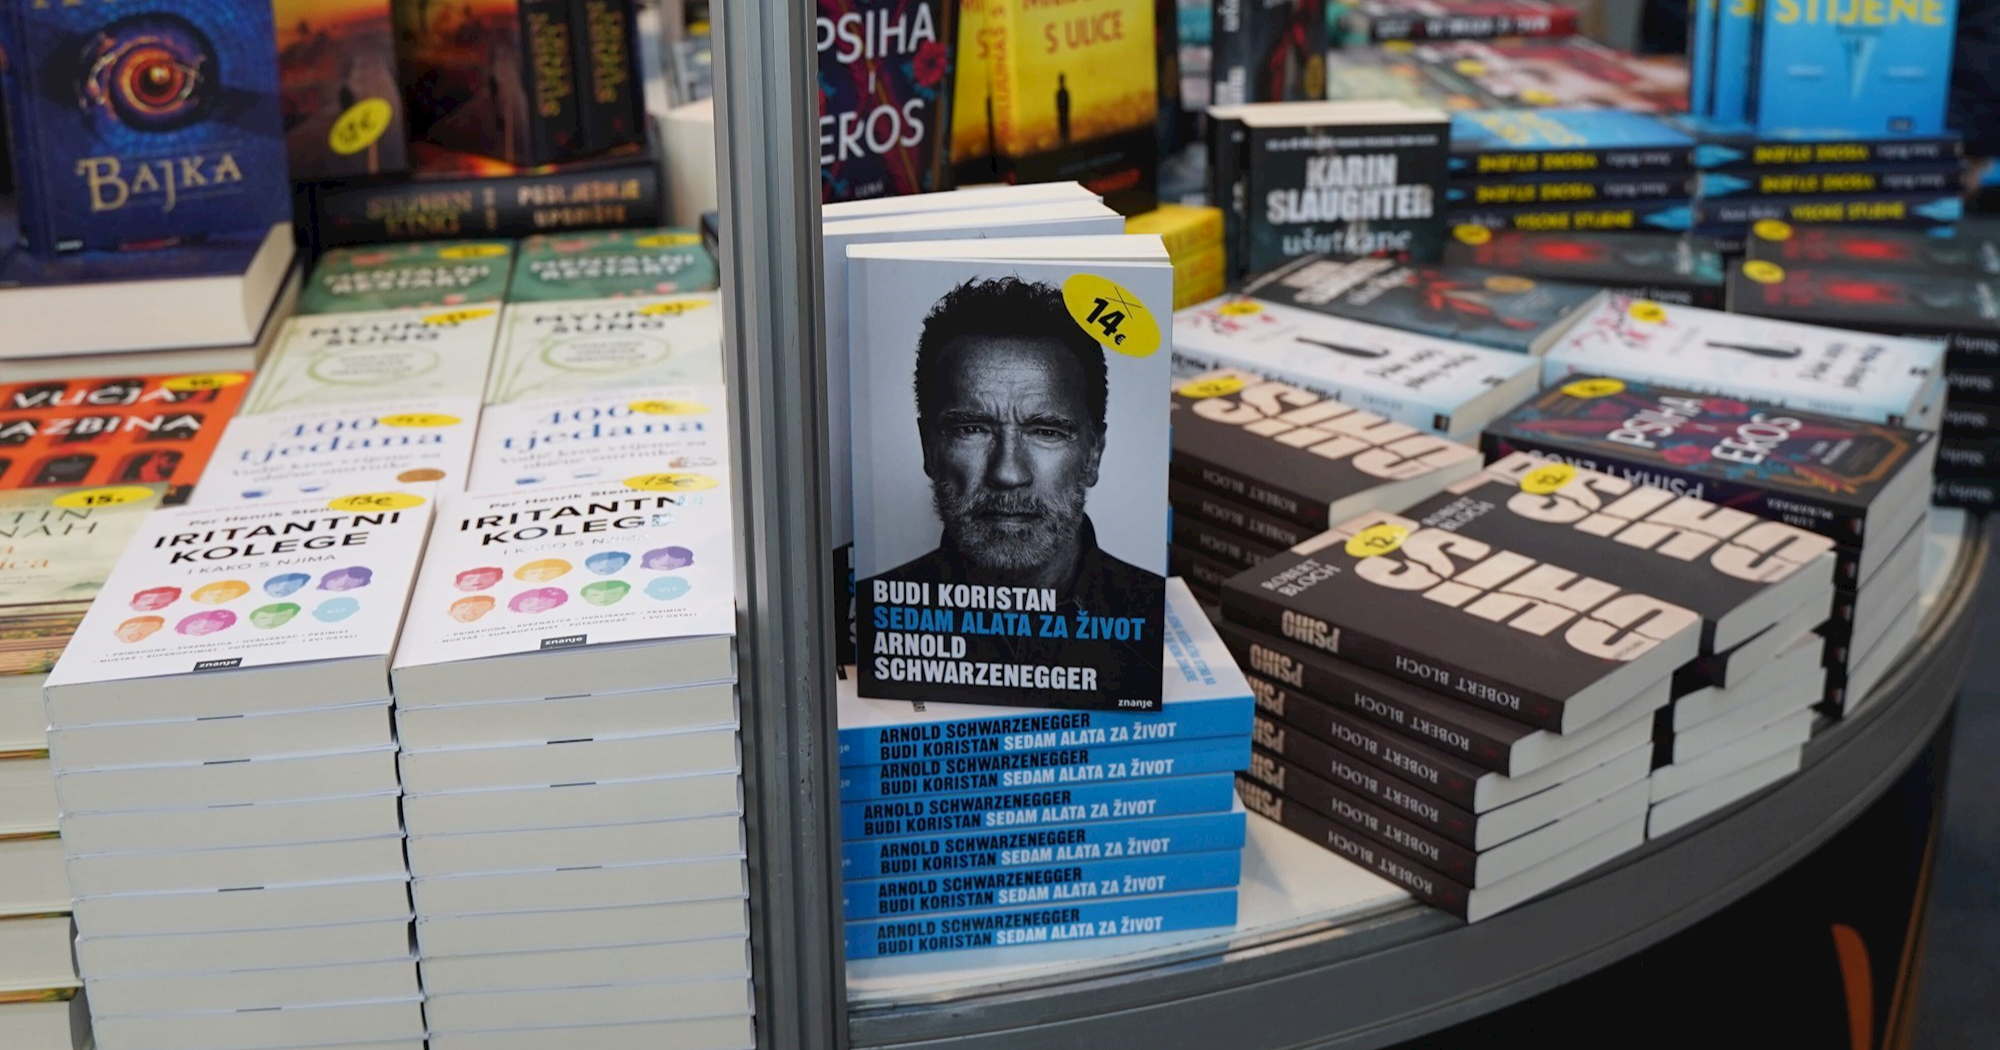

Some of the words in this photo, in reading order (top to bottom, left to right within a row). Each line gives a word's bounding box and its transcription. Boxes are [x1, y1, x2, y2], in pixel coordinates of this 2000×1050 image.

[820, 98, 925, 165] EROS
[75, 152, 243, 214] BAJKA
[1306, 154, 1398, 189] KARIN
[1266, 185, 1434, 225] SLAUGHTER
[1086, 297, 1126, 346] 14€
[0, 412, 202, 438] AZBINA
[1606, 395, 1702, 449] PSIHA
[1711, 412, 1803, 465] EROS
[153, 511, 402, 549] IRITANTNI
[169, 531, 371, 564] KOLEGE
[1261, 558, 1321, 591] ROBERT
[1278, 564, 1341, 598] BLOCH
[873, 580, 929, 606] BUDI
[938, 583, 1056, 613] KORISTAN
[873, 606, 954, 633] SEDAM
[961, 611, 1031, 636] ALATA
[1039, 614, 1069, 639] ZA
[1075, 610, 1146, 641] ŽIVOT
[1281, 609, 1340, 654] PSIHO
[873, 631, 967, 659] ARNOLD
[874, 656, 1098, 691] SCHWARZENEGGER
[1250, 643, 1304, 688] PSIHO
[1395, 654, 1449, 686] BLOCH
[1118, 697, 1154, 710] znanje
[1354, 691, 1405, 724] BLOCH
[1455, 676, 1520, 711] ROBERT
[880, 726, 941, 744] ARNOLD
[946, 713, 1090, 741] SCHWARZENEGGER
[880, 744, 918, 761] BUDI
[923, 738, 999, 758] KORISTAN
[1004, 732, 1056, 751] SEDAM
[1060, 728, 1105, 746] ALATA
[1110, 726, 1129, 741] ZA
[1133, 721, 1177, 740] ŽIVOT
[1331, 721, 1378, 755] BLOCH
[1410, 714, 1470, 751] ROBERT
[880, 762, 941, 780] ARNOLD
[946, 749, 1089, 777] SCHWARZENEGGER
[881, 780, 918, 795] BUDI
[923, 774, 998, 793] KORISTAN
[1003, 769, 1054, 787] SEDAM
[1058, 764, 1103, 782] ALATA
[1107, 763, 1127, 778] ZA
[1130, 758, 1174, 776] ŽIVOT
[1331, 759, 1378, 793] BLOCH
[1382, 746, 1439, 785] ROBERT
[864, 802, 924, 820] ARNOLD
[929, 790, 1072, 816] SCHWARZENEGGER
[865, 820, 902, 836] BUDI
[907, 814, 981, 832] KORISTAN
[986, 809, 1038, 827] SEDAM
[1042, 805, 1086, 823] ALATA
[1091, 803, 1110, 818] ZA
[1113, 798, 1157, 817] ŽIVOT
[1331, 797, 1379, 831] BLOCH
[1382, 784, 1439, 824] ROBERT
[880, 840, 940, 859] ARNOLD
[946, 829, 1086, 855] SCHWARZENEGGER
[881, 858, 918, 874] BUDI
[922, 853, 997, 871] KORISTAN
[1001, 848, 1052, 866] SEDAM
[1056, 843, 1101, 861] ALATA
[1105, 841, 1124, 857] ZA
[1127, 837, 1170, 854] ŽIVOT
[1327, 829, 1374, 864] BLOCH
[1382, 822, 1440, 862] ROBERT
[878, 879, 937, 898] ARNOLD
[943, 867, 1082, 894] SCHWARZENEGGER
[1378, 855, 1434, 896] ROBERT
[879, 897, 916, 914] BUDI
[920, 891, 994, 911] KORISTAN
[998, 886, 1049, 904] SEDAM
[1053, 881, 1097, 899] ALATA
[1101, 879, 1120, 895] ZA
[1123, 875, 1166, 893] ŽIVOT
[877, 919, 936, 939] ARNOLD
[941, 908, 1080, 935] SCHWARZENEGGER
[878, 938, 915, 955] BUDI
[919, 932, 992, 951] KORISTAN
[997, 927, 1047, 945] SEDAM
[1051, 922, 1095, 940] ALATA
[1099, 920, 1118, 936] ZA
[1120, 916, 1163, 934] ŽIVOT
